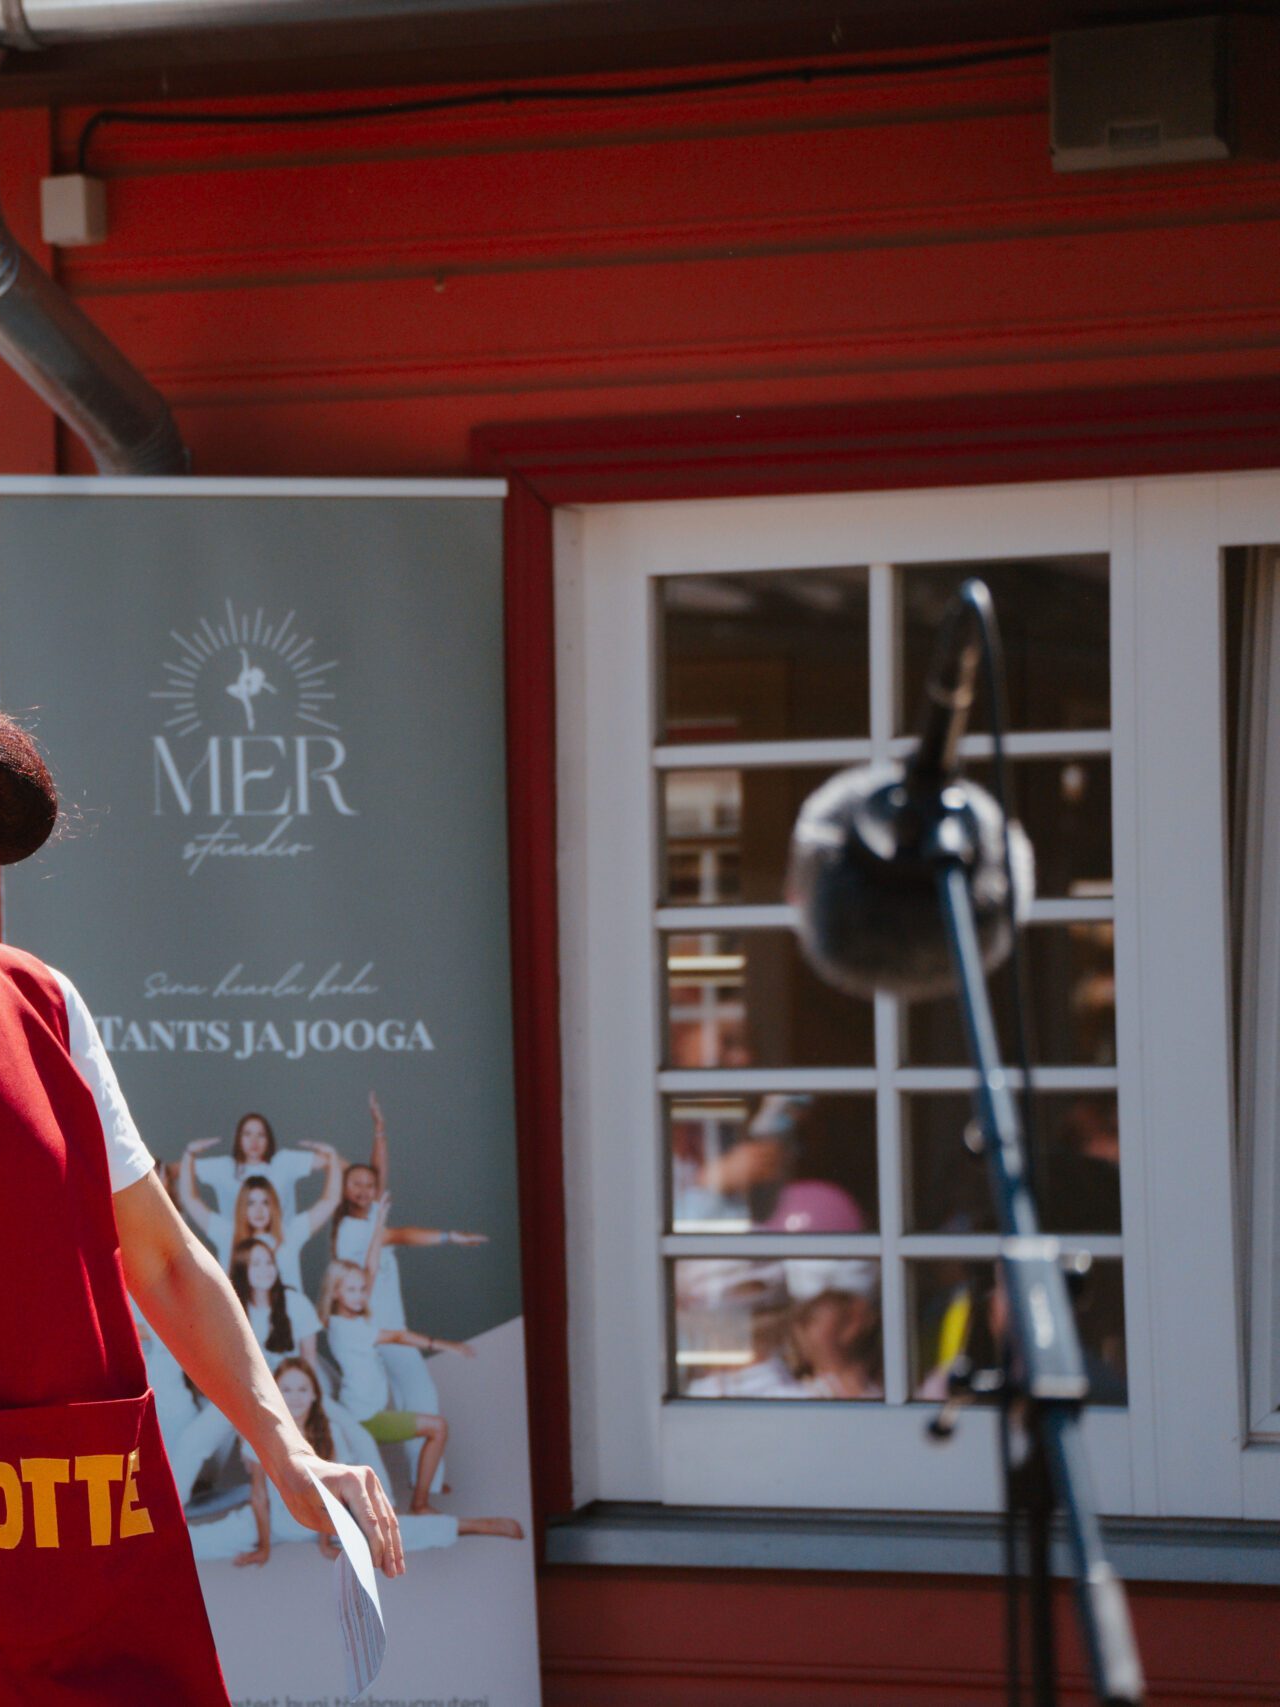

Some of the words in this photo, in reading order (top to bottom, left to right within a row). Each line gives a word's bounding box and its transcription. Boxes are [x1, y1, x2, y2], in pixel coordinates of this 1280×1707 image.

[152, 735, 361, 816] MER
[182, 815, 314, 877] studio
[93, 1016, 230, 1051] TANTS
[234, 1020, 286, 1060] JA
[286, 1018, 435, 1060] JOOGA
